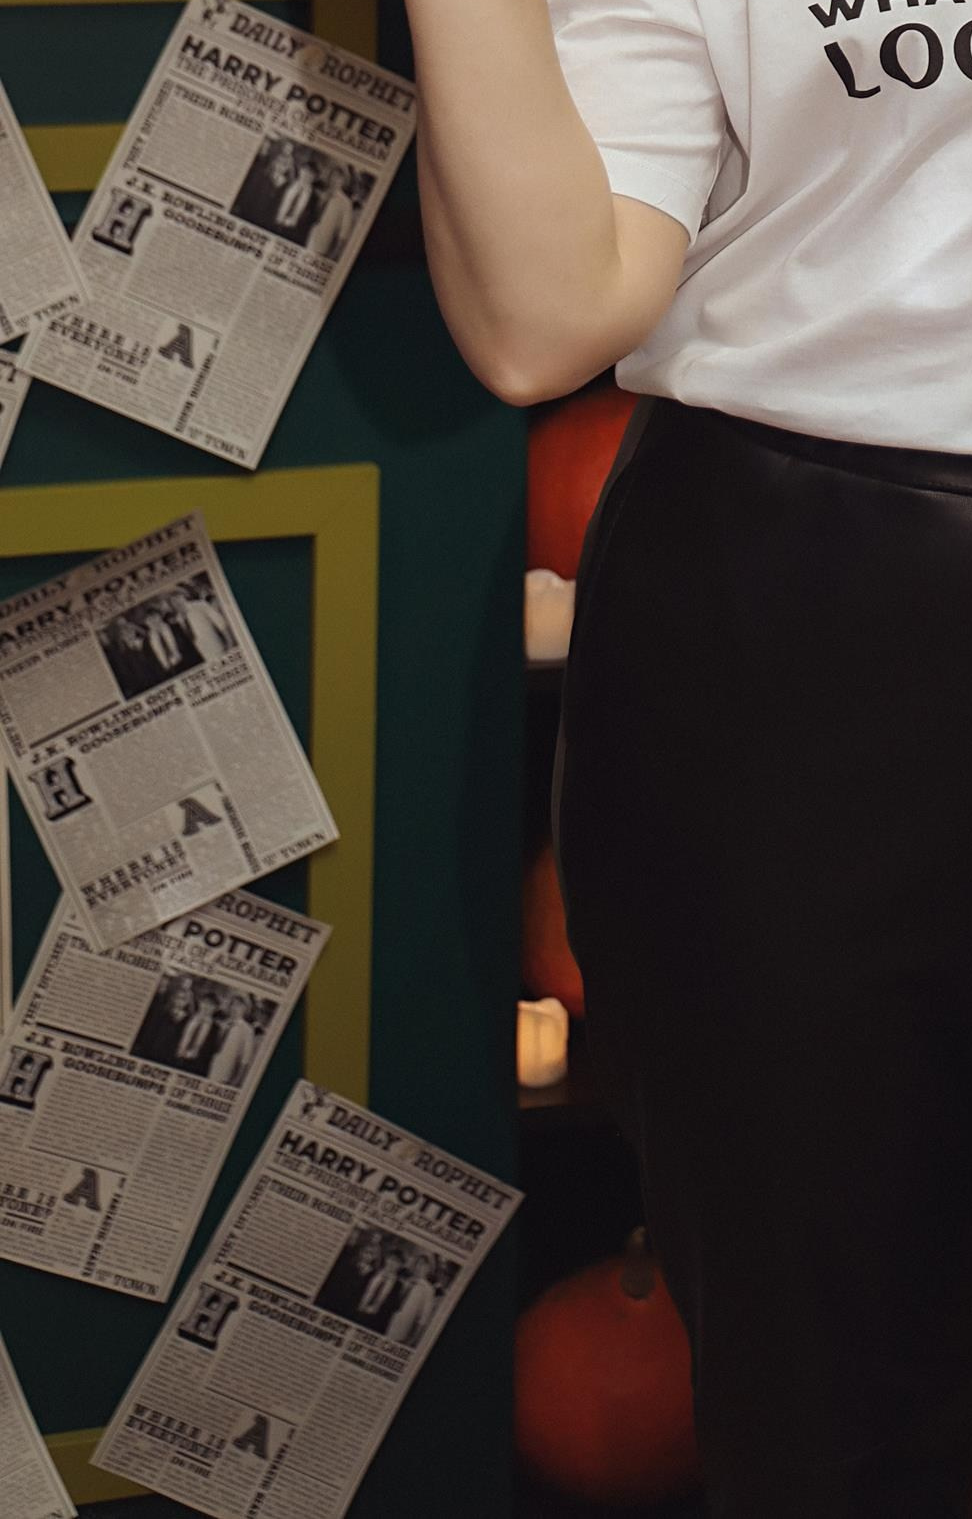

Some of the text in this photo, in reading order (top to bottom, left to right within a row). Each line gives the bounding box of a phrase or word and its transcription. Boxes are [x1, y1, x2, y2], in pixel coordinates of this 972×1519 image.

[230, 13, 304, 57] DAILY
[181, 35, 395, 146] HARRY POTTER
[0, 600, 71, 645] ARRY
[82, 541, 197, 604] POTTER
[215, 892, 319, 943] ROPHET
[183, 920, 296, 975] POTTER
[327, 1105, 400, 1150] DAILY
[279, 1131, 485, 1239] HARRY POTTER
